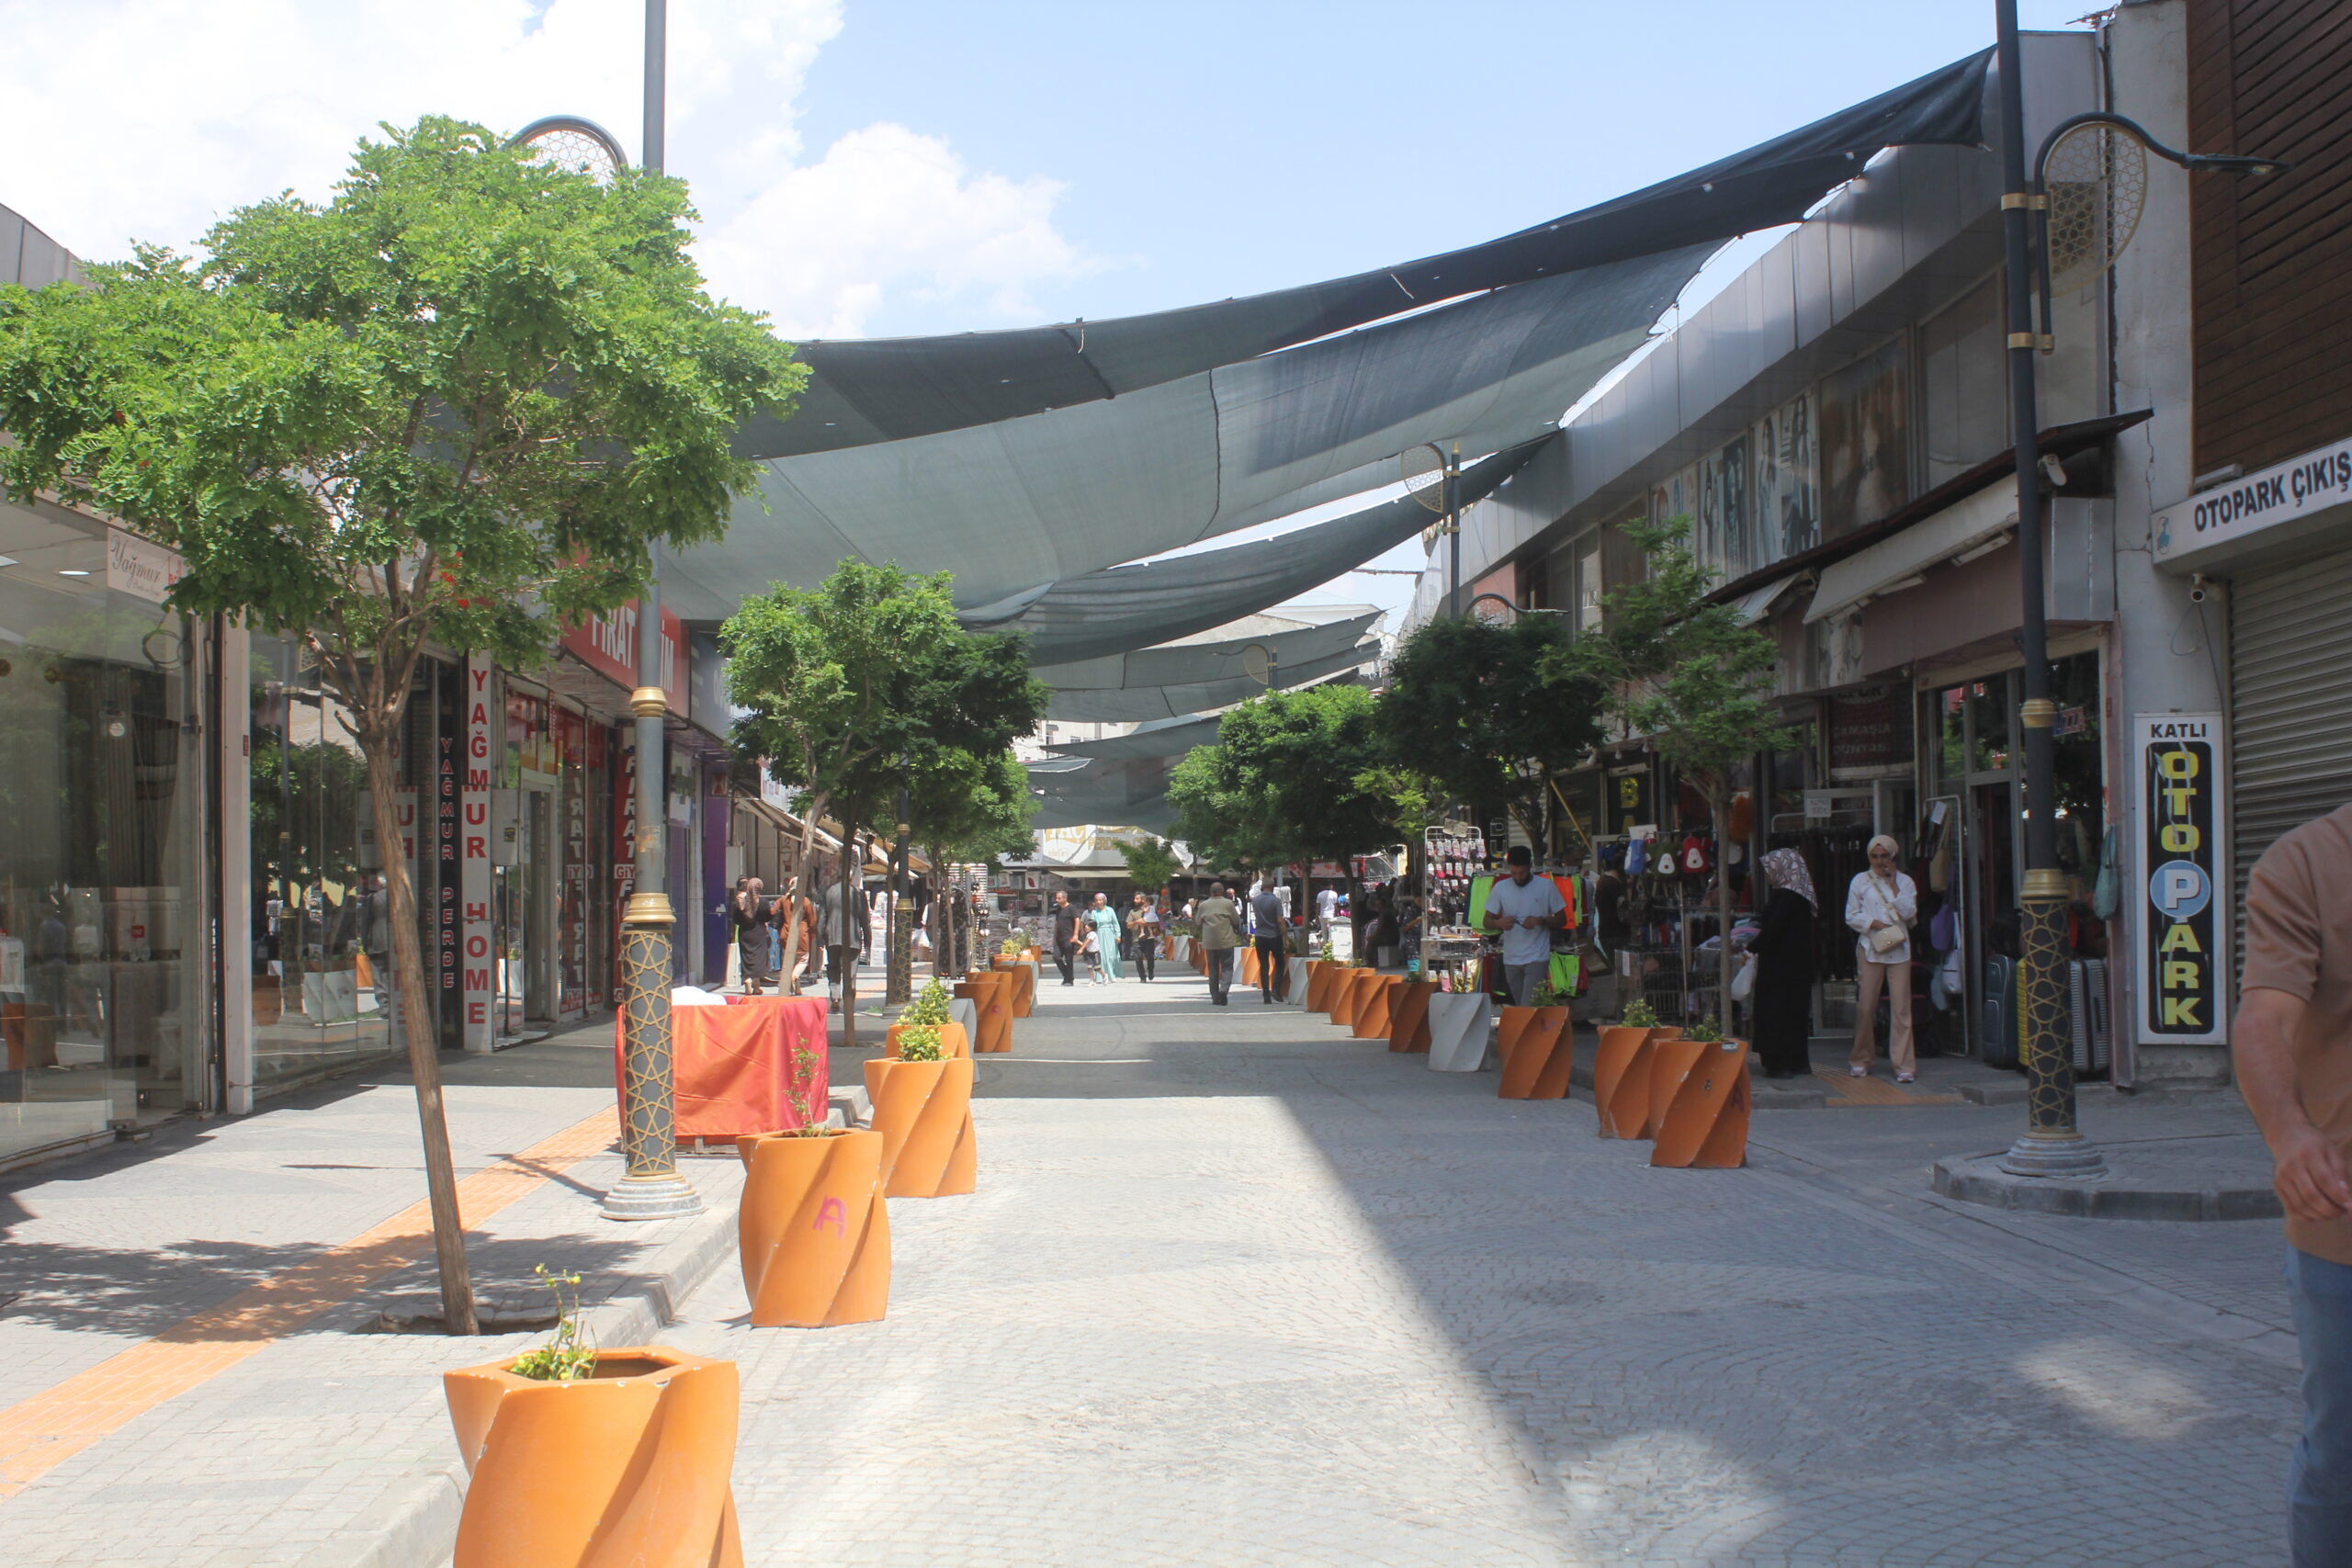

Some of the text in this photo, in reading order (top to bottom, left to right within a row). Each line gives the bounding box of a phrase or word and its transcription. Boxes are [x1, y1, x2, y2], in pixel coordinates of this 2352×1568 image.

[2194, 451, 2352, 533] OTOPARK ÇIKIŞ
[2150, 723, 2207, 738] KATLI
[463, 669, 489, 1024] YAĞMUR HOME
[2159, 750, 2203, 1026] OTOPARK
[441, 886, 455, 988] PERDE
